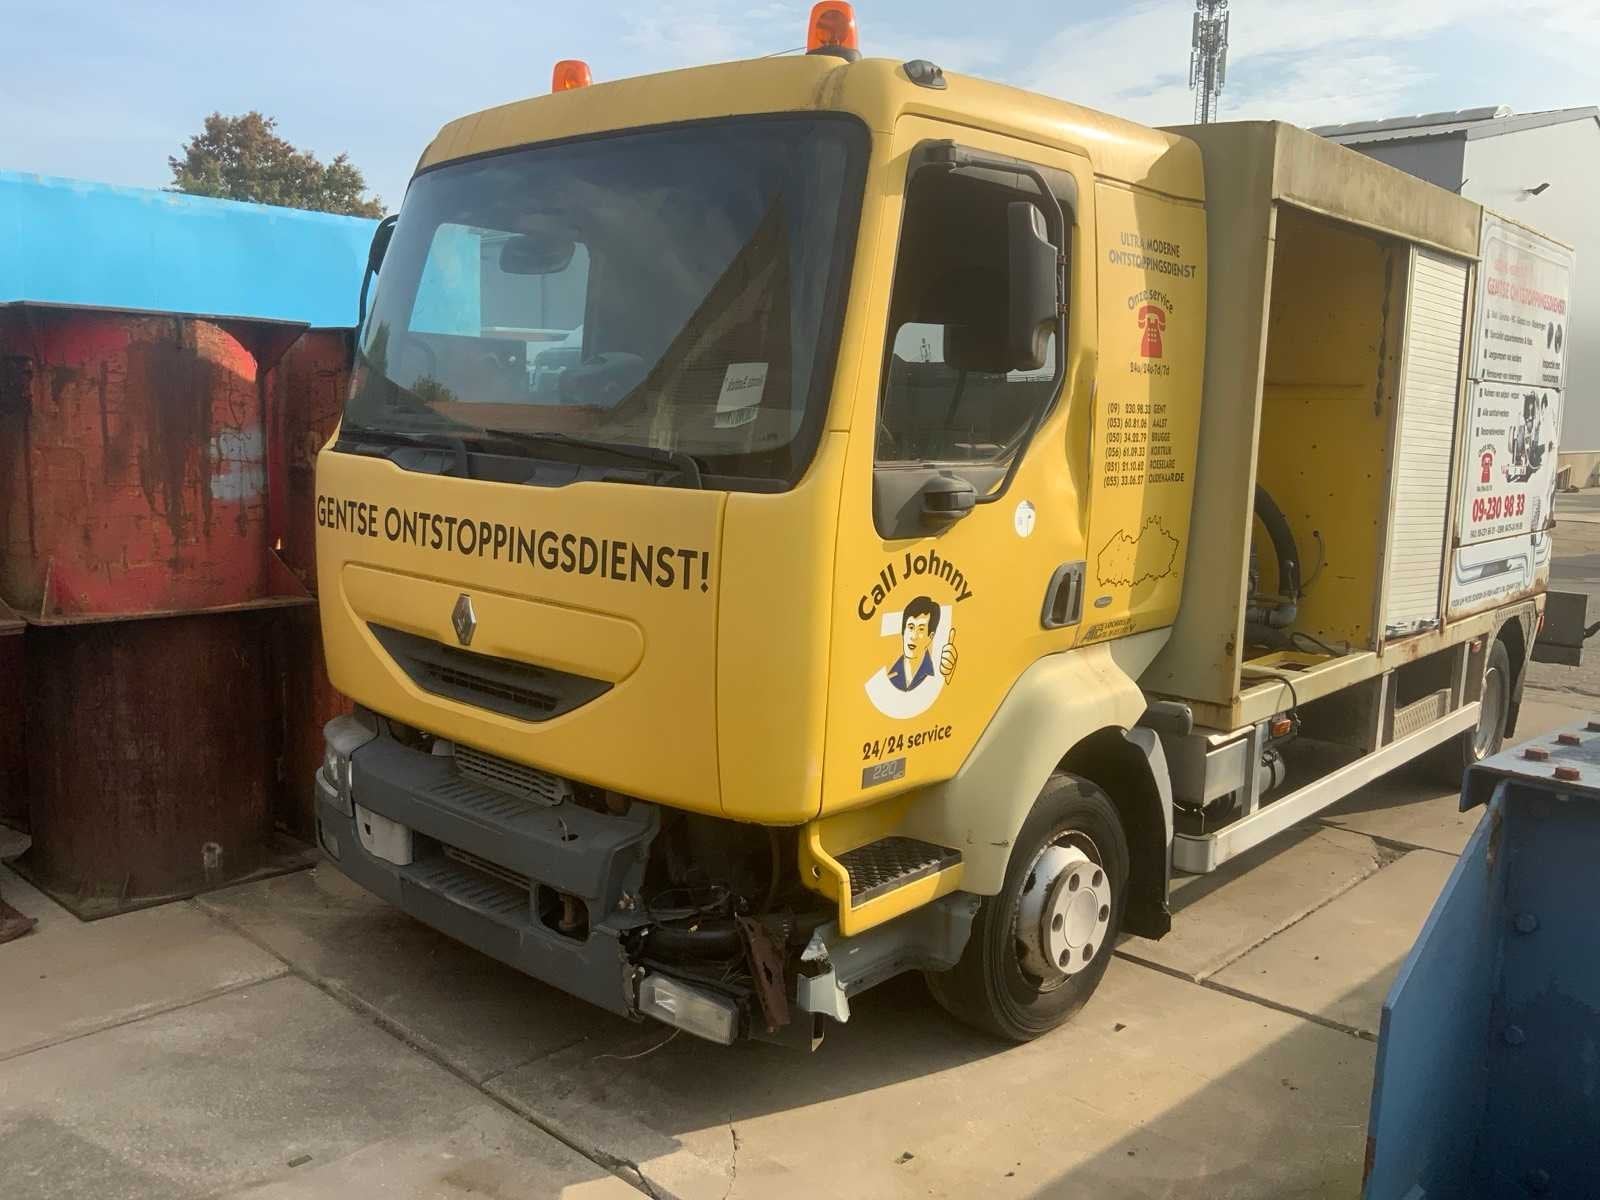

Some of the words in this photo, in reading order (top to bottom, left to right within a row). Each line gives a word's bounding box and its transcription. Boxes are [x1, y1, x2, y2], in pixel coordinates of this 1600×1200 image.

[1120, 231, 1144, 248] ULTRA
[1147, 238, 1181, 258] MODERNE
[1108, 250, 1197, 279] ONTSTOPPINGSDIENST
[1149, 288, 1174, 314] service
[1107, 402, 1120, 415] (09)
[1153, 404, 1167, 414] GENT
[1106, 417, 1123, 430] (053)
[1151, 418, 1168, 428] AALST
[1151, 432, 1171, 442] BRUGGE
[1105, 447, 1121, 459] (056)
[1104, 461, 1120, 474] (051)
[1103, 475, 1119, 488] (055)
[1472, 495, 1502, 523] 09-230
[1503, 495, 1514, 519] 98
[1515, 493, 1526, 516] 33
[316, 494, 379, 537] GENTSE
[384, 507, 710, 593] ONTSTOPPINGSDIENST!
[857, 563, 898, 622] Call
[902, 549, 973, 603] Johnny
[862, 733, 904, 761] 24/24
[907, 724, 953, 749] service
